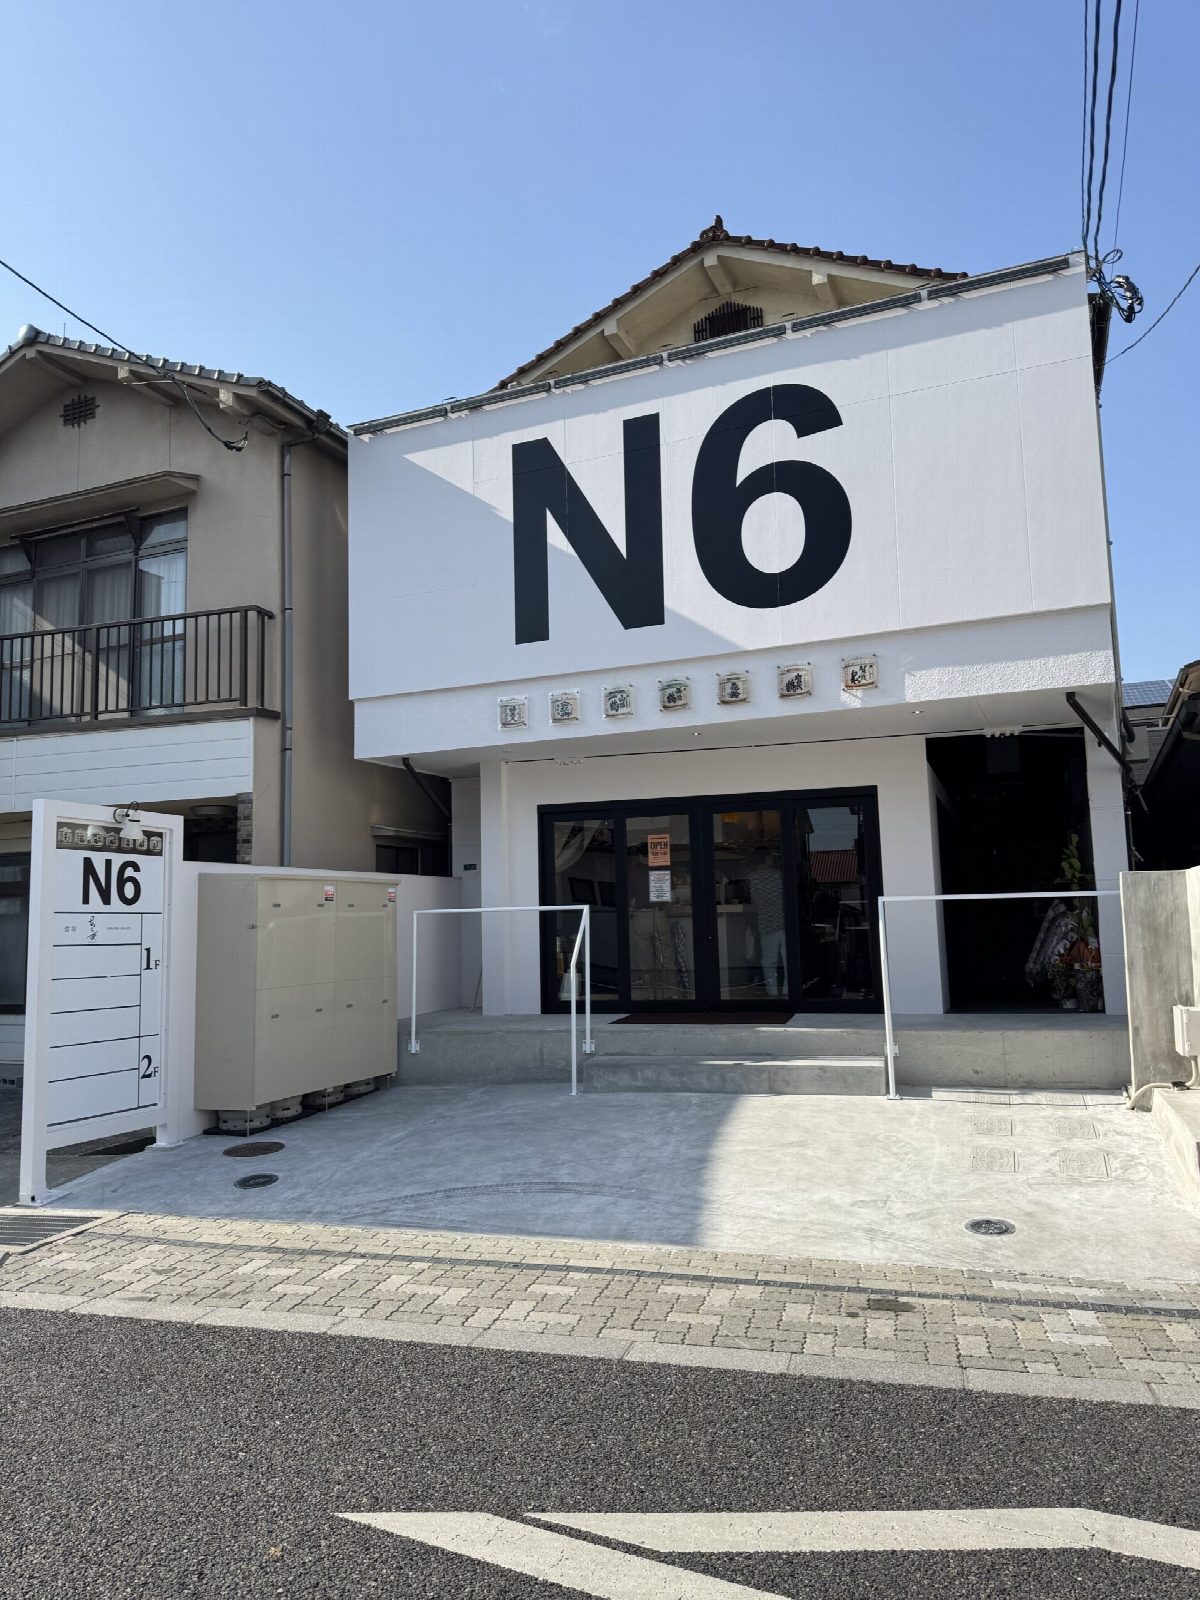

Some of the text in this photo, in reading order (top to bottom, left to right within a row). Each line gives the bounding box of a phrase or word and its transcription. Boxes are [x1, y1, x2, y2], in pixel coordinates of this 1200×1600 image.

[511, 383, 853, 645] N6
[650, 841, 669, 850] OPEN
[82, 856, 142, 906] N6
[142, 946, 161, 971] 1F
[140, 1054, 160, 1080] 2F
